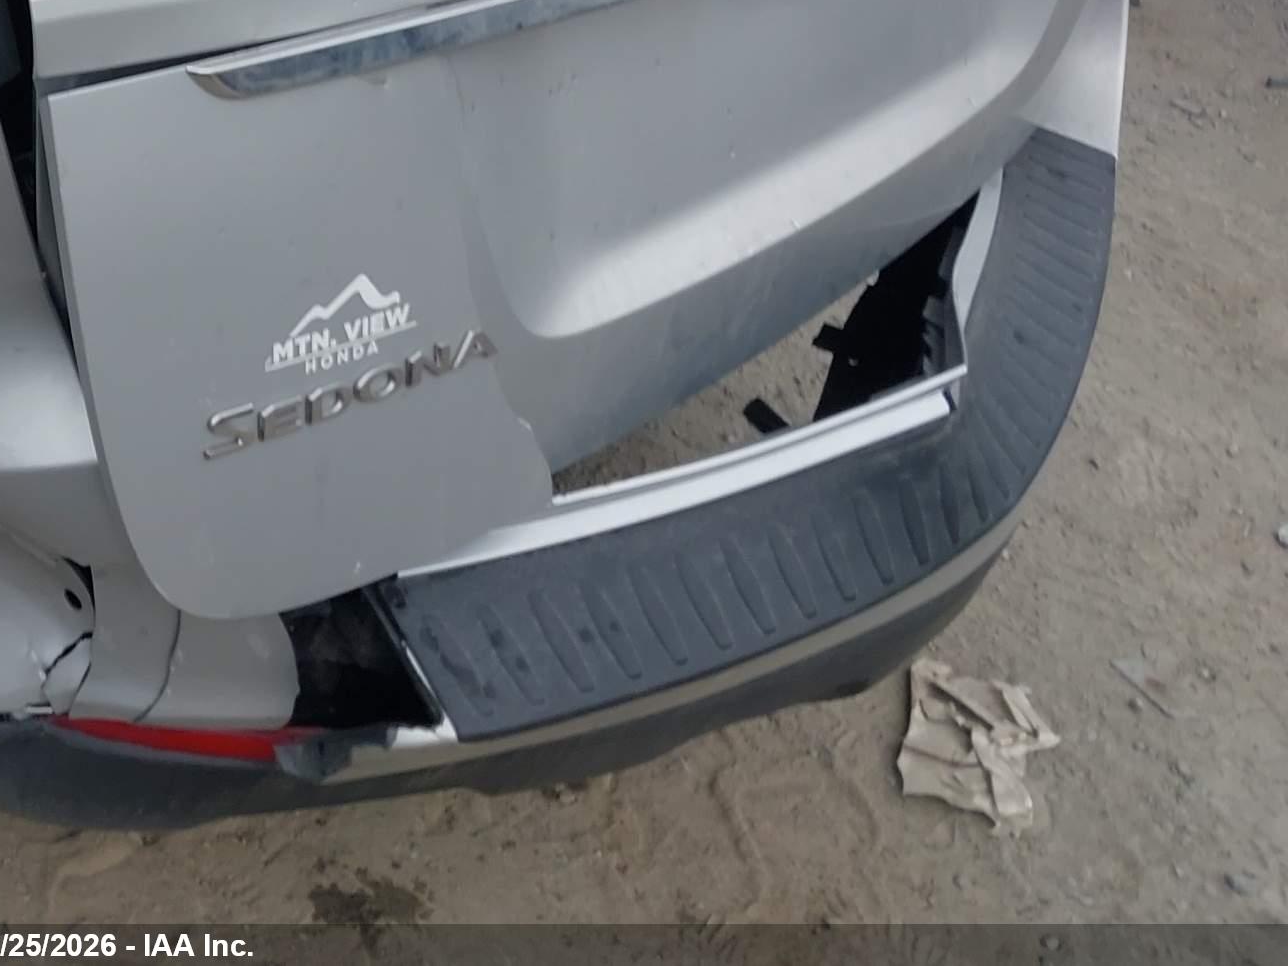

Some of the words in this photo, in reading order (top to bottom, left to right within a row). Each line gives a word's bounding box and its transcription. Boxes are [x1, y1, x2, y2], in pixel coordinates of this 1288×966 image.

[344, 302, 410, 341] VIEW
[305, 343, 379, 374] HONDA
[203, 330, 499, 461] SEDONA
